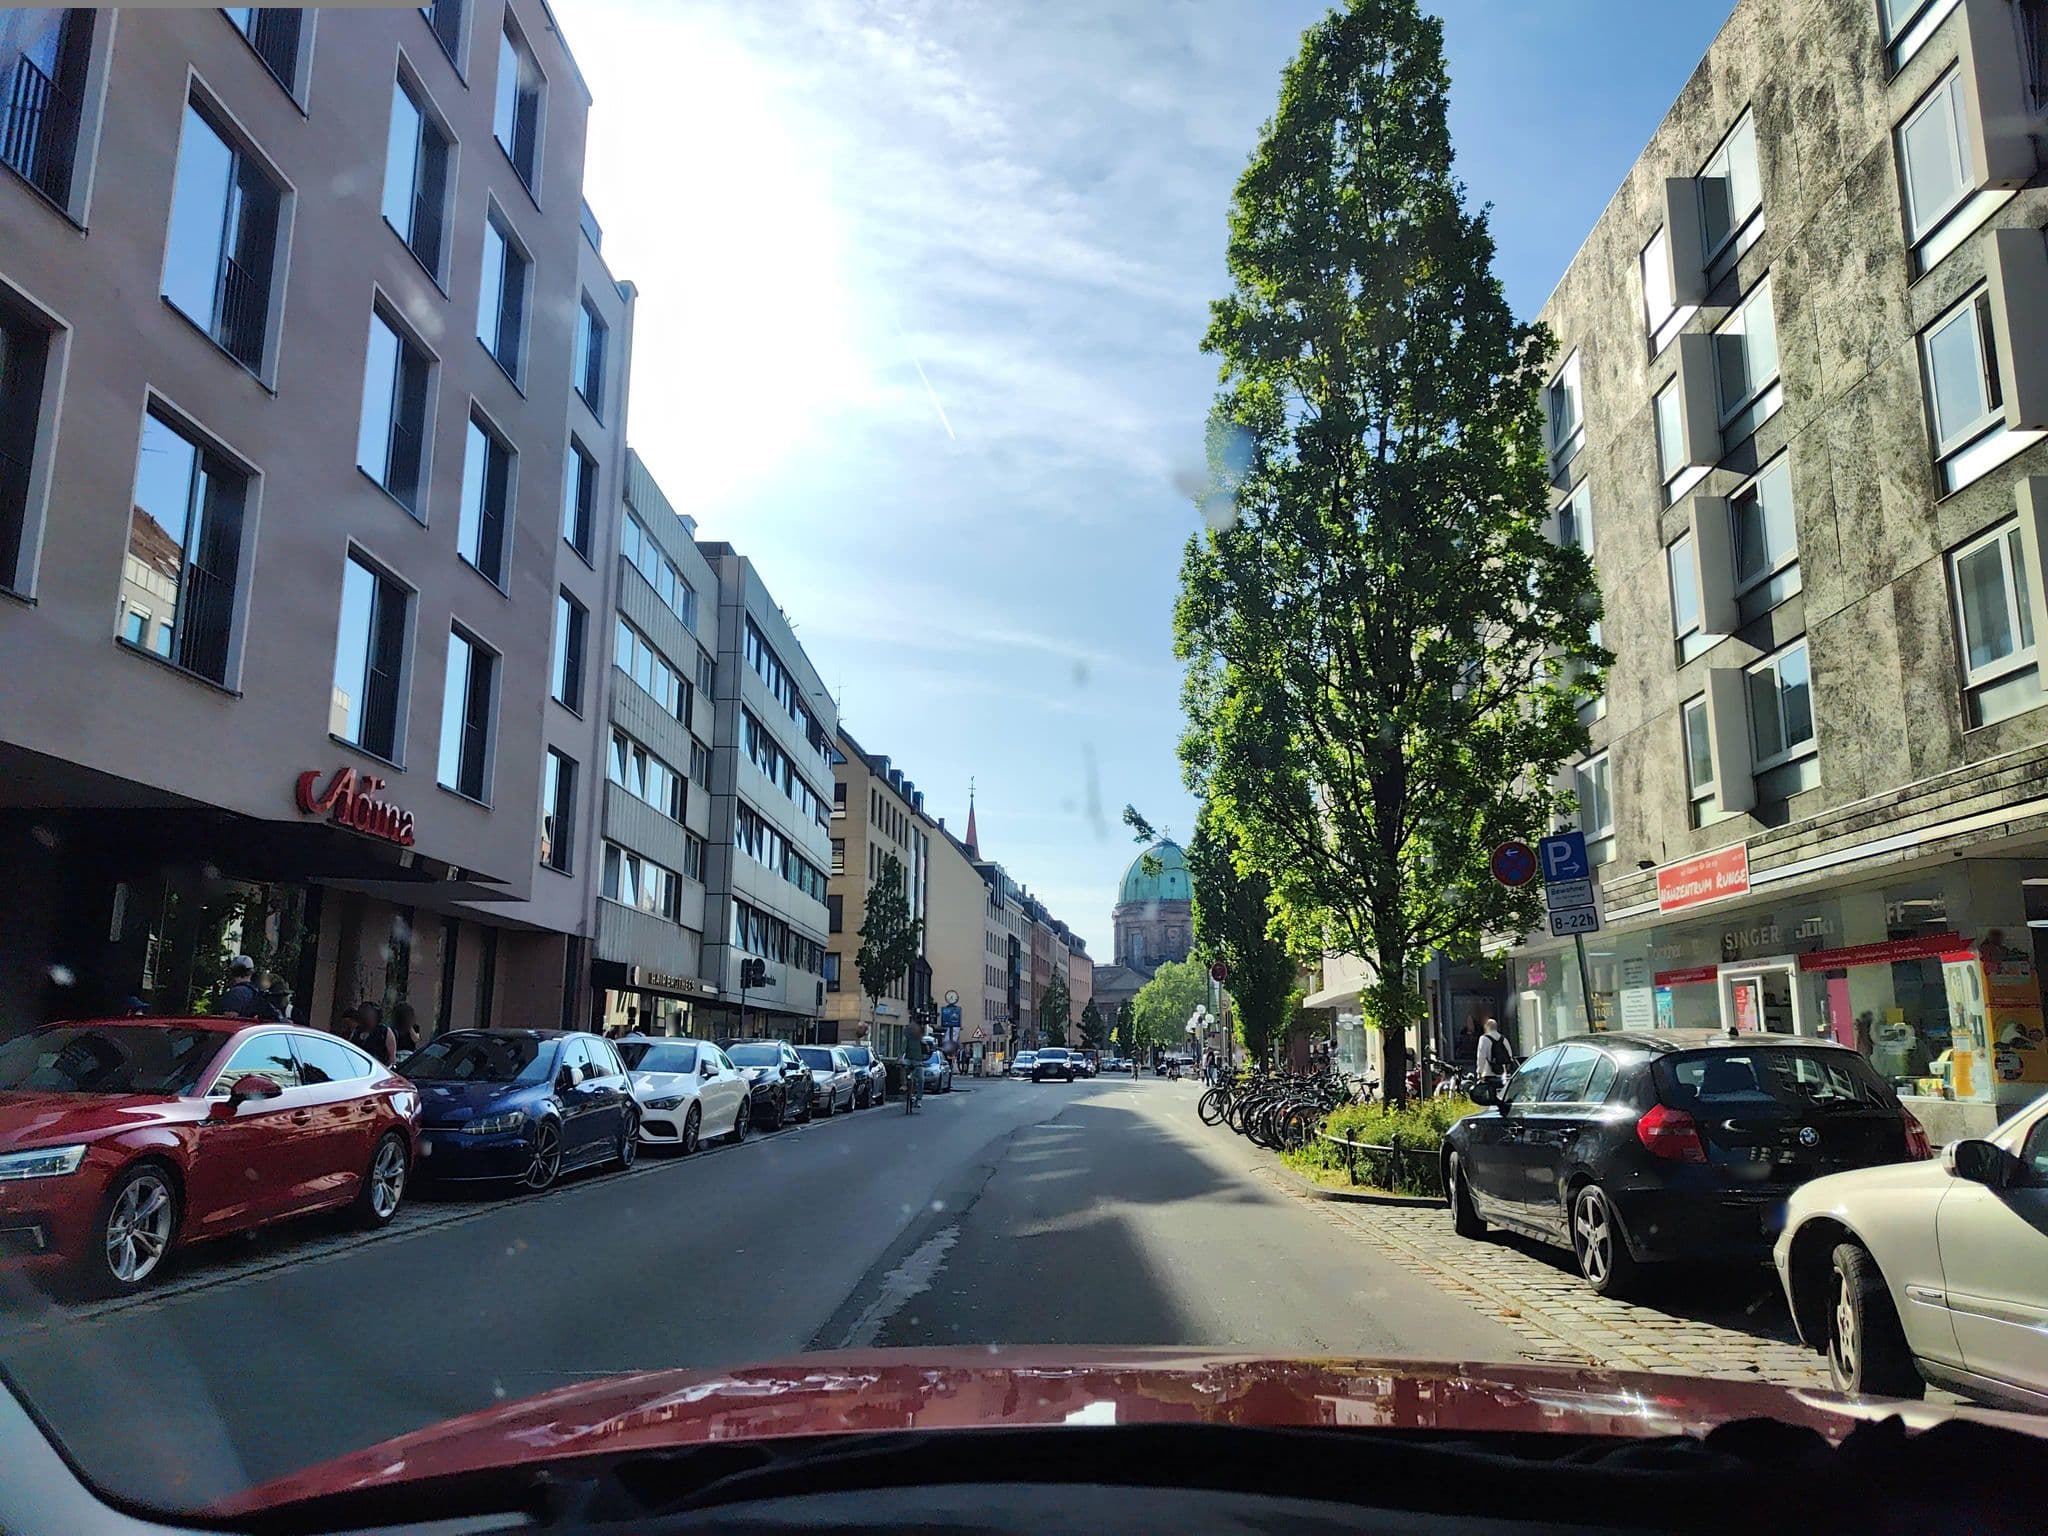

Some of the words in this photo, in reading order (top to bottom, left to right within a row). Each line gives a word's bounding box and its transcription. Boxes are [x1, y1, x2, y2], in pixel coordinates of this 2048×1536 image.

[296, 768, 415, 846] Adina
[1547, 841, 1572, 876] P
[1554, 913, 1594, 930] 8-22h
[1725, 925, 1780, 950] SINGER
